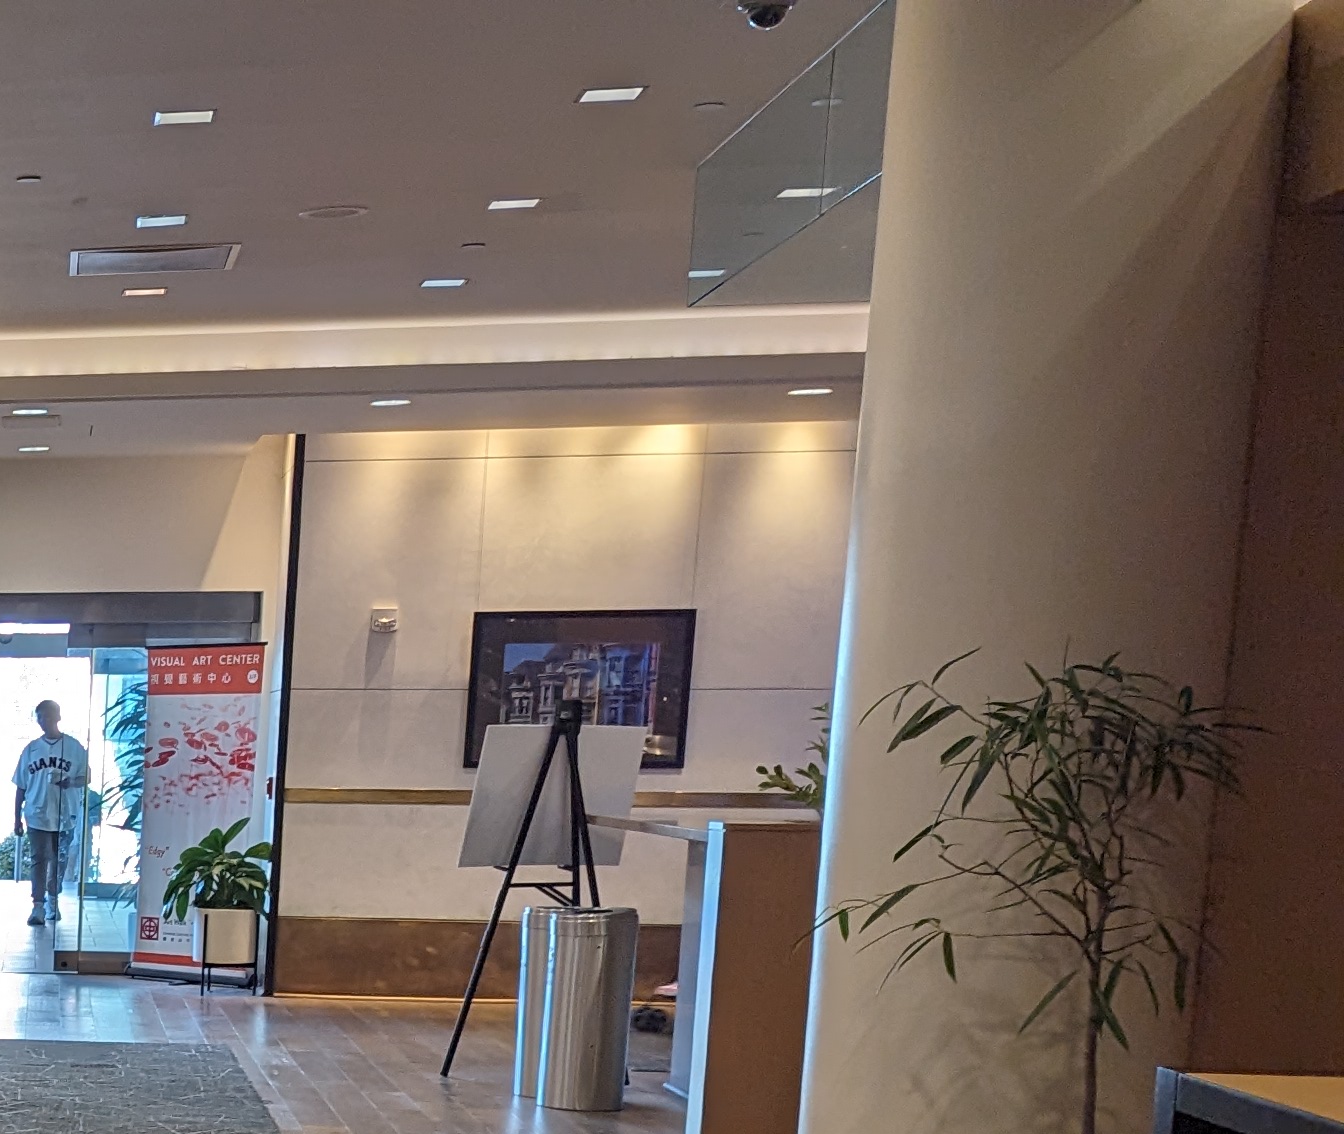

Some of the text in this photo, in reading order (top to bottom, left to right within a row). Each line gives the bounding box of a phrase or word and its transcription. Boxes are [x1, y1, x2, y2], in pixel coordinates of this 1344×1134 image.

[150, 654, 260, 667] VISUAL ART CENTER
[28, 756, 72, 775] GIANTS
